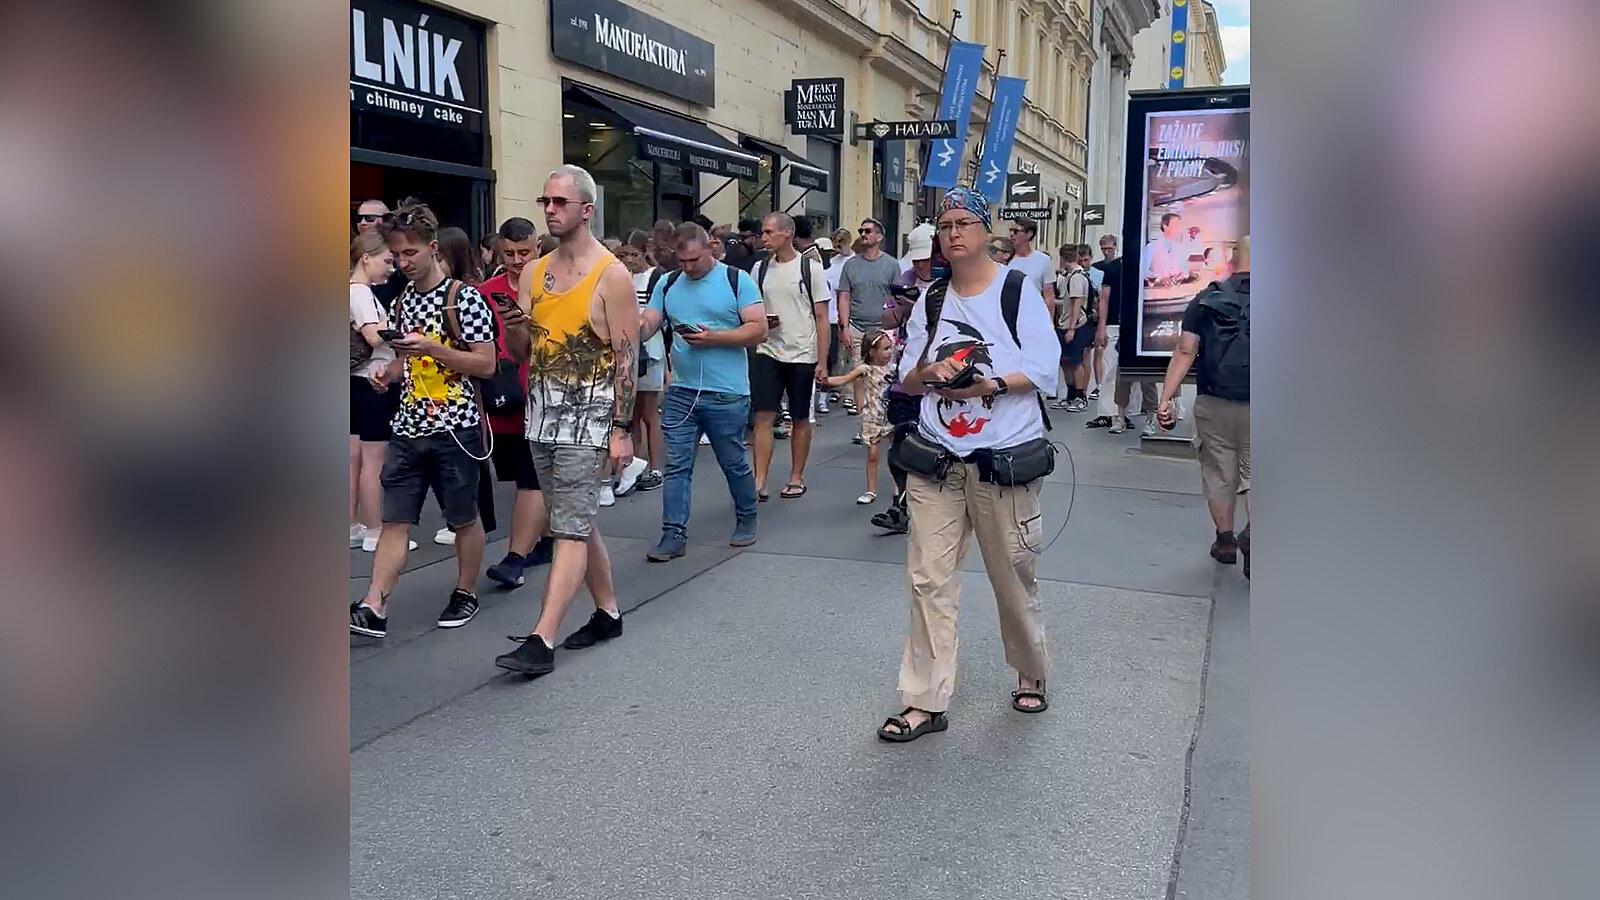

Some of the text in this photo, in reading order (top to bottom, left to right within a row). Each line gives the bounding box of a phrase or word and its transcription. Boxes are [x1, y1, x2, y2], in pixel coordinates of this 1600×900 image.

[353, 8, 465, 102] LNÍK
[796, 83, 837, 104] M FAKT
[366, 92, 424, 119] chimney
[434, 107, 463, 123] cake
[819, 110, 835, 129] M
[895, 123, 950, 136] HALADA
[1004, 210, 1049, 219] CANDY SHOP
